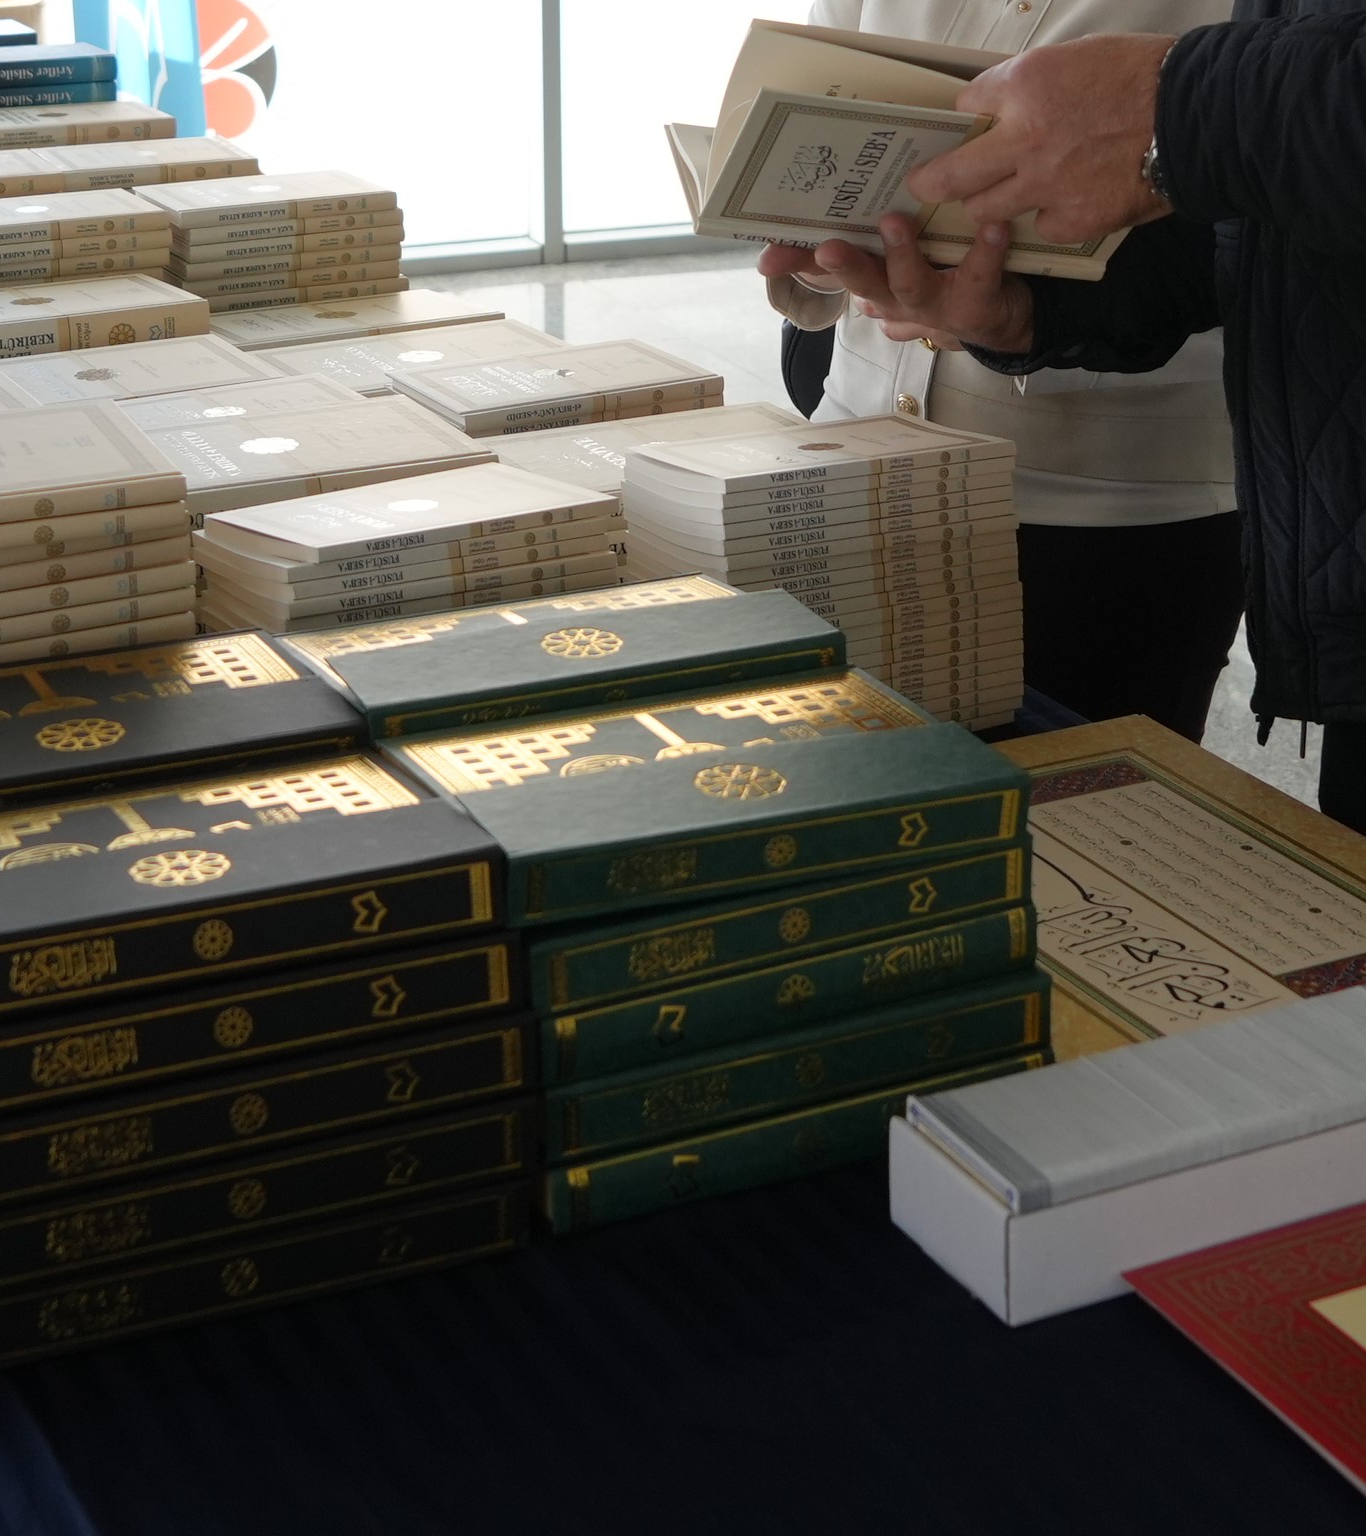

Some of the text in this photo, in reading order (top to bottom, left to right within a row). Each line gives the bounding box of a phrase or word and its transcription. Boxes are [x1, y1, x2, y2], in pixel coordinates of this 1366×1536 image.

[37, 66, 74, 79] Ârifler
[241, 211, 262, 219] KADER
[30, 230, 47, 238] KAZÂ
[250, 227, 270, 236] KADER
[0, 232, 22, 240] KADER
[33, 249, 50, 257] KAZÂ
[249, 245, 269, 254] KADER
[3, 251, 25, 260] KADER
[29, 268, 47, 276] KAZÂ
[245, 264, 266, 272] KADER
[0, 270, 21, 279] KADER
[241, 281, 262, 289] KADER
[250, 299, 272, 308] KADER
